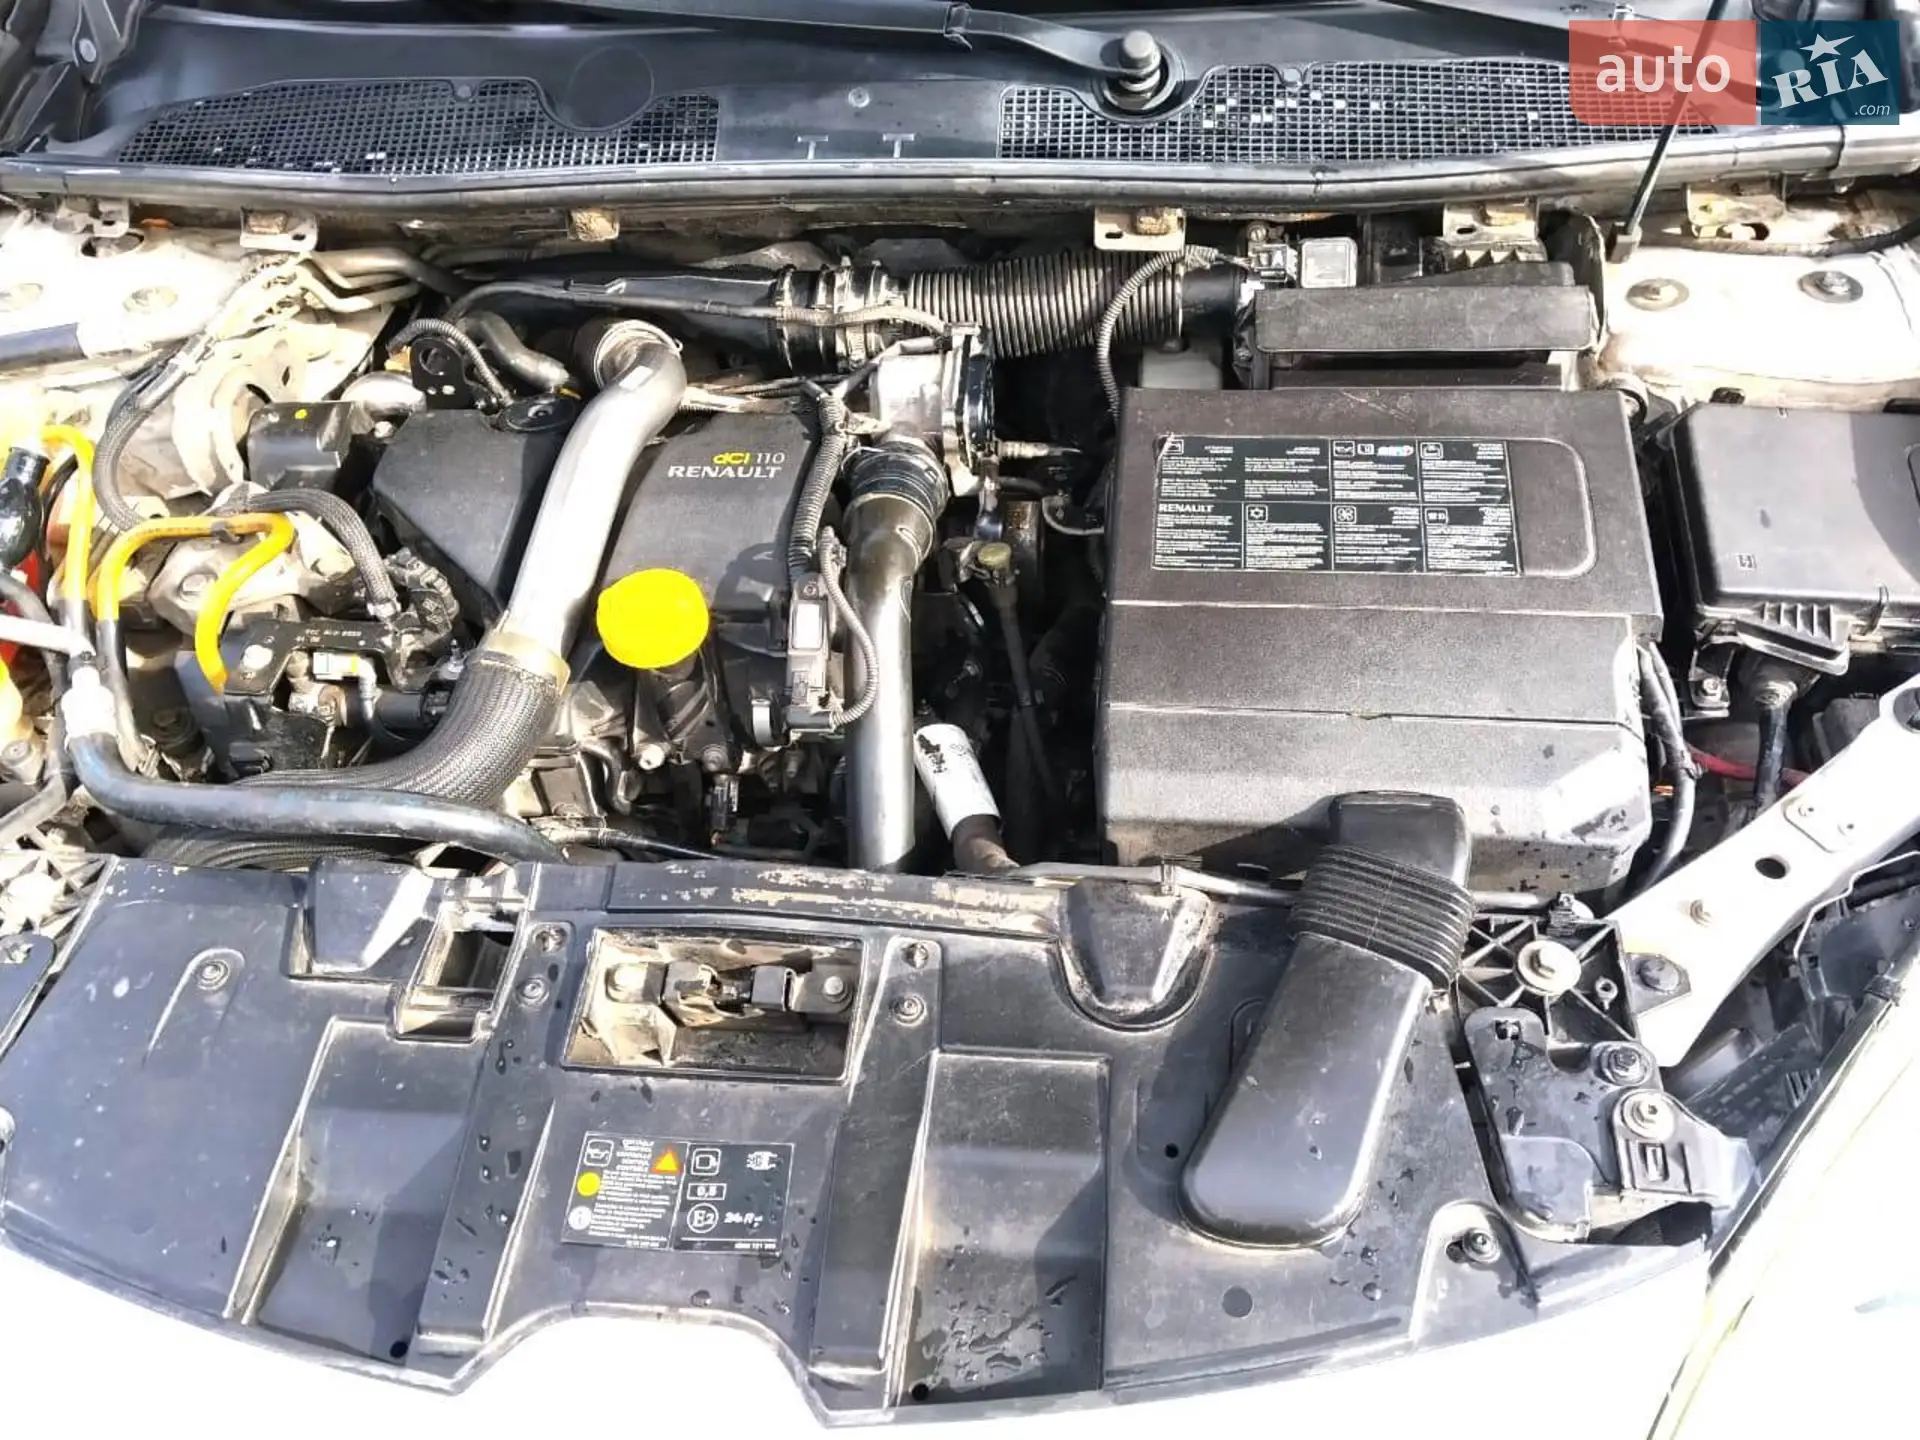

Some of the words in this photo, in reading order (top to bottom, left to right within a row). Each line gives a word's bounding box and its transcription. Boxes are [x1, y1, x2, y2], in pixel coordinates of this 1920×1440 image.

[756, 452, 786, 465] 110
[668, 465, 782, 479] RENAULT
[1158, 503, 1215, 513] RENAULT
